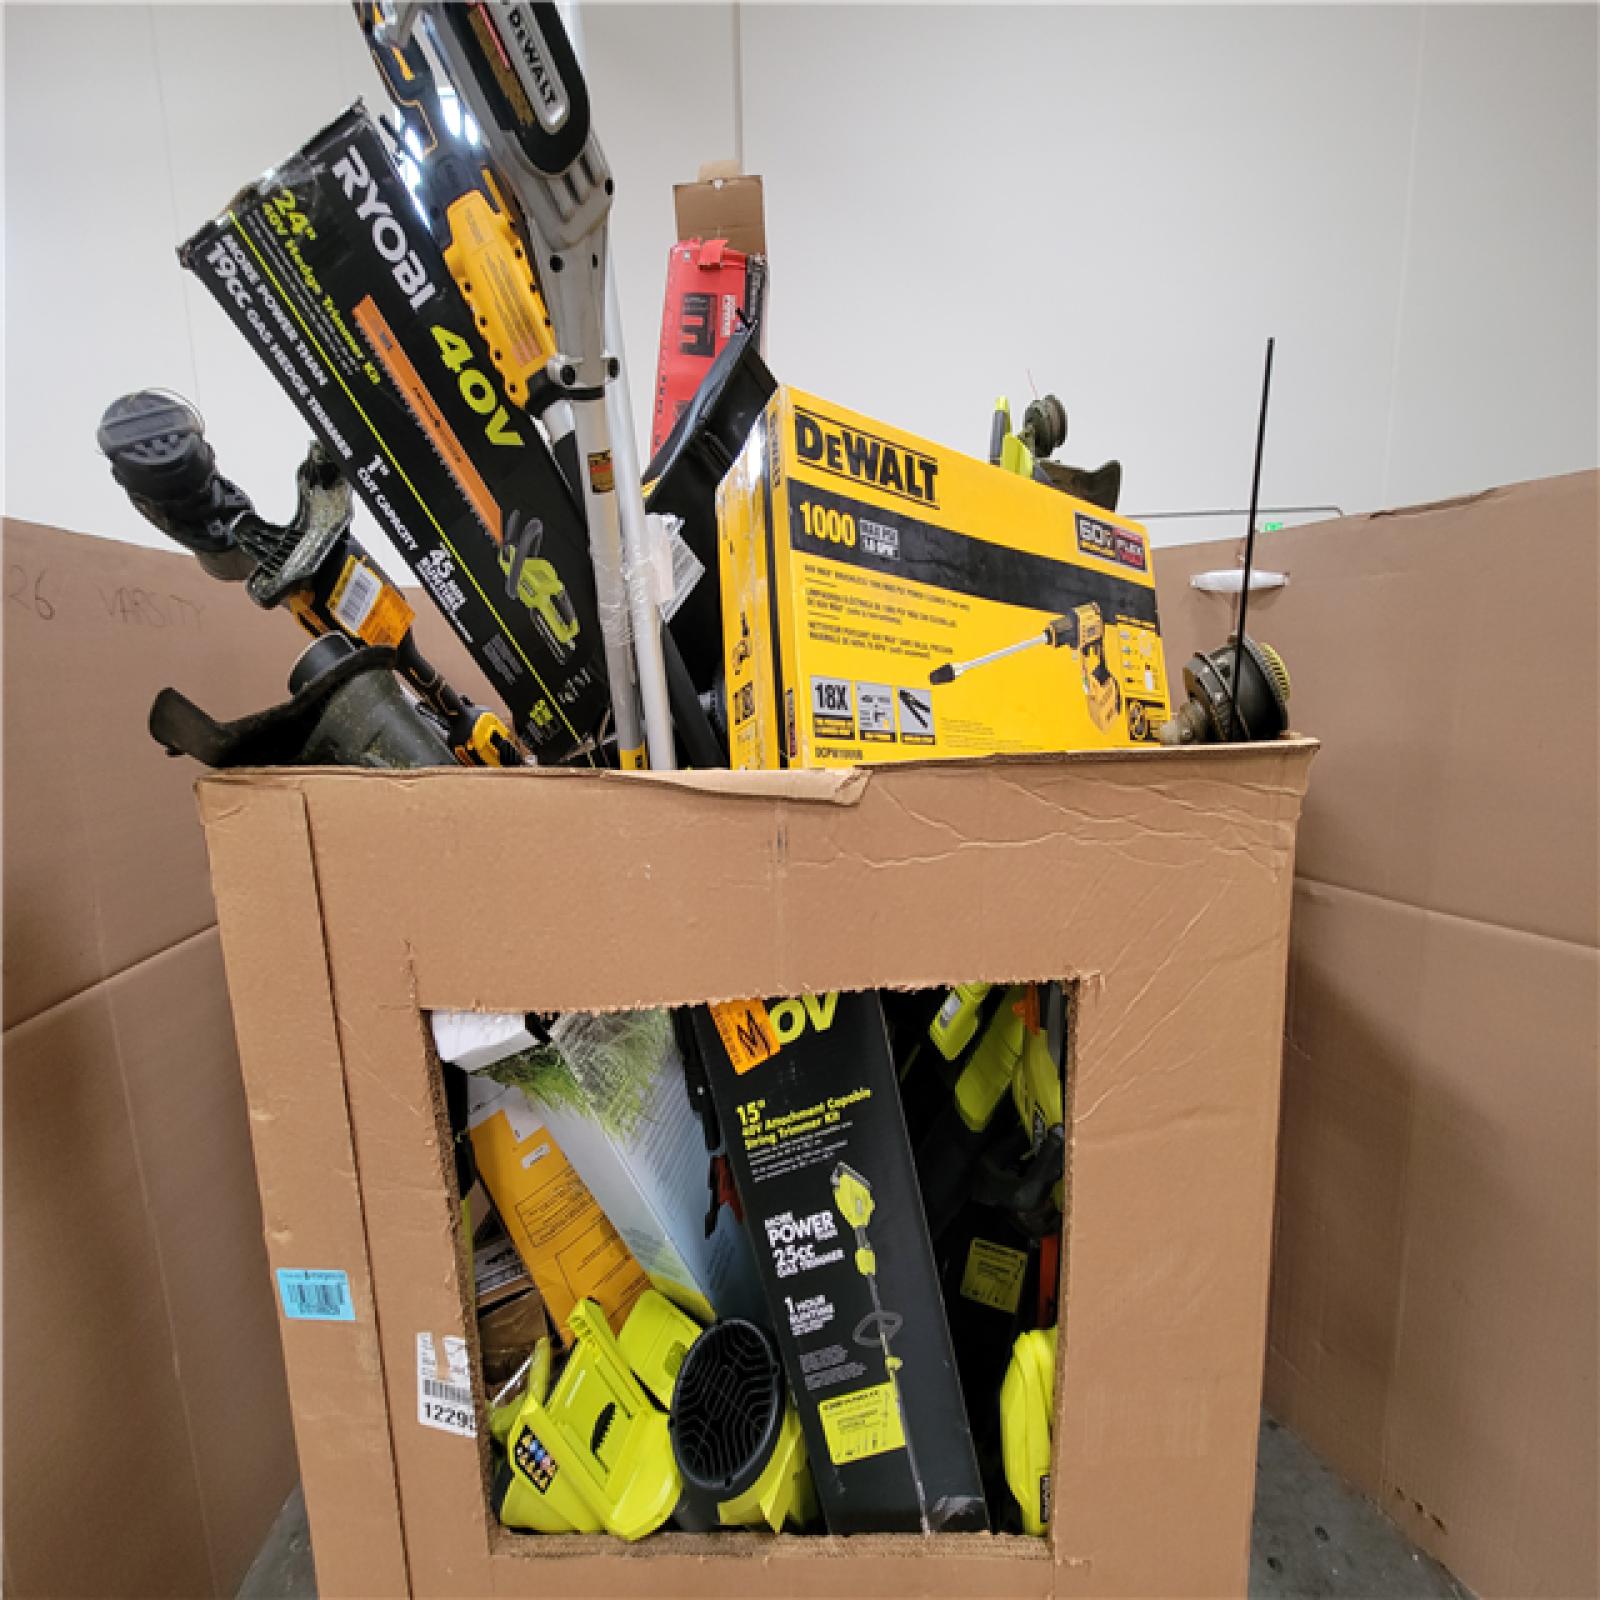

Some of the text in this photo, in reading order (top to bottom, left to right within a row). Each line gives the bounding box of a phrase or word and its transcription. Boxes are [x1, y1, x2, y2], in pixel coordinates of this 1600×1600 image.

[332, 145, 436, 313] RYOBI
[255, 284, 299, 343] POWER
[297, 339, 328, 386] THAN
[247, 309, 274, 344] GAS
[270, 343, 311, 395] HEDGE
[308, 395, 353, 460] TRIMMER
[430, 324, 524, 449] 40V
[794, 414, 939, 501] DEWALT
[357, 466, 419, 550] CUT CAPACITY
[800, 500, 856, 547] 1000
[815, 682, 849, 711] 18X
[767, 1210, 836, 1248] POWER
[784, 1296, 795, 1314] 1
